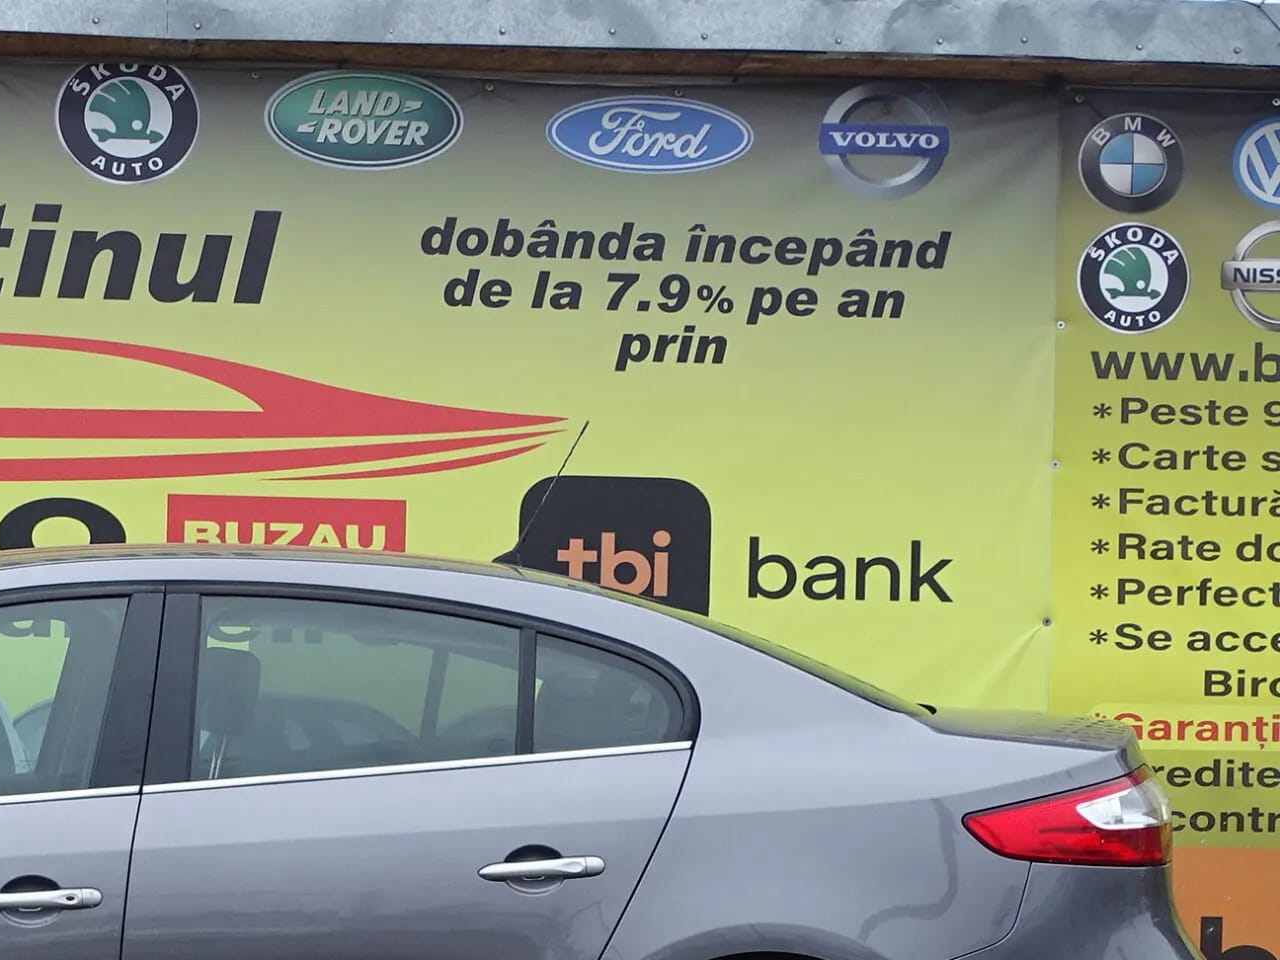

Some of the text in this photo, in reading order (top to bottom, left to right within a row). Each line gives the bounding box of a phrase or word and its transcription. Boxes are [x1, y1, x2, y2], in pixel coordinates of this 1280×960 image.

[315, 118, 430, 147] ROVER
[587, 107, 711, 160] Ford
[828, 130, 941, 150] VOLVO
[1091, 116, 1177, 150] BMW
[90, 154, 164, 177] AUTO
[419, 216, 953, 277] dobânda începând
[1233, 267, 1280, 284] NIS
[442, 268, 907, 326] de la 7.9% pe an
[1103, 309, 1162, 328] AUTO
[613, 324, 729, 372] prin
[1090, 341, 1280, 383] www.b
[556, 529, 954, 603] tbi bank
